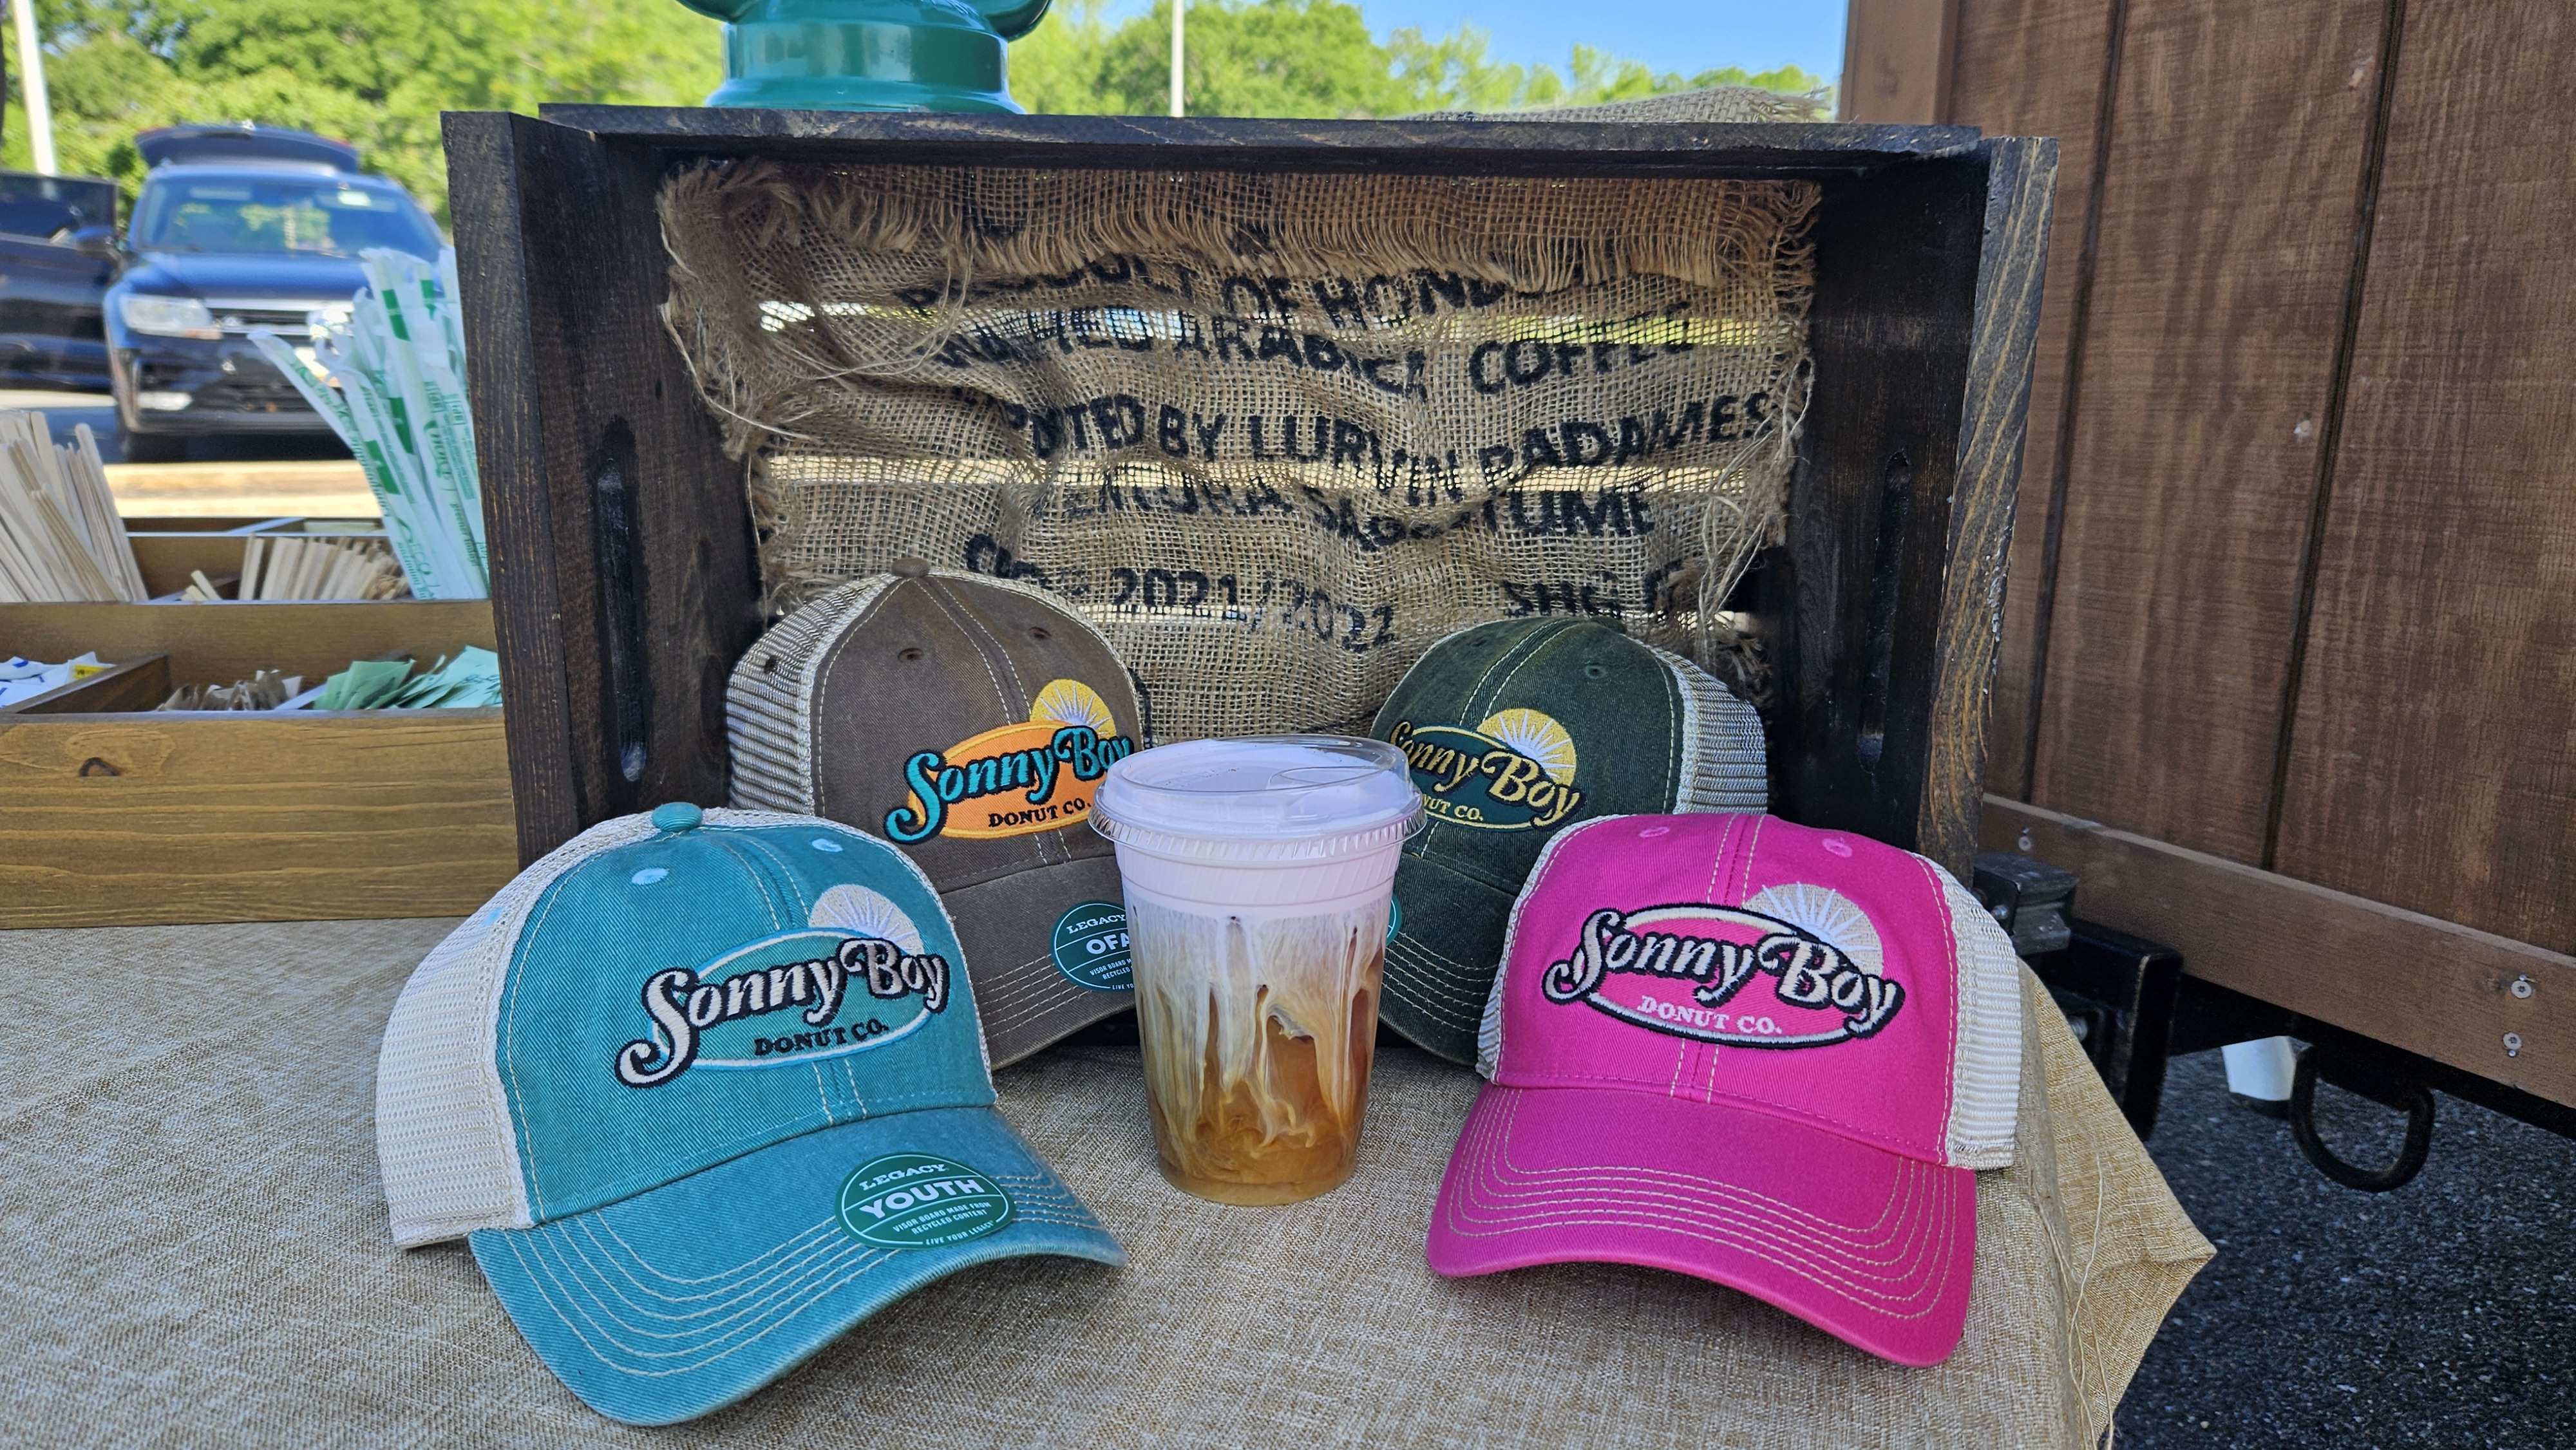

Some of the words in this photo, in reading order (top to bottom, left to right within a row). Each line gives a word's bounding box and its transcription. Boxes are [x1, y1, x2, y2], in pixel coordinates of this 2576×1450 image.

[1226, 275, 1301, 323] OF
[1470, 301, 1695, 395] COFFEE
[1159, 403, 1227, 464] BY
[884, 749, 1059, 845] Sonny
[1422, 794, 1450, 813] NUT
[1454, 805, 1484, 822] CO.
[1481, 748, 1586, 831] Boy
[988, 807, 1058, 828] DONUT
[1063, 798, 1091, 814] CO.
[1066, 914, 1126, 934] LEGACY
[1089, 965, 1108, 976] VISOR
[1107, 959, 1126, 970] BOARD
[1102, 967, 1131, 980] RECYCLED
[1541, 907, 1756, 1008] Sonny
[1756, 932, 1906, 1039] Boy
[614, 956, 848, 1089] Sonny
[837, 937, 951, 1013] Boy
[1637, 995, 1730, 1031] DONUT
[1736, 1015, 1783, 1035] CO.
[753, 1028, 846, 1057] DONUT
[851, 1019, 890, 1041] CO.
[859, 1163, 947, 1191] LEGACY
[859, 1179, 985, 1219] YOUTH
[893, 1217, 918, 1233] VISOR
[918, 1209, 947, 1225] BOARD
[947, 1204, 969, 1215] MADE
[969, 1201, 992, 1210] FROM
[911, 1217, 952, 1236] RECYCLED
[952, 1209, 989, 1222] CONTENT
[925, 1236, 945, 1246] LIVE
[947, 1230, 969, 1242] YOUR
